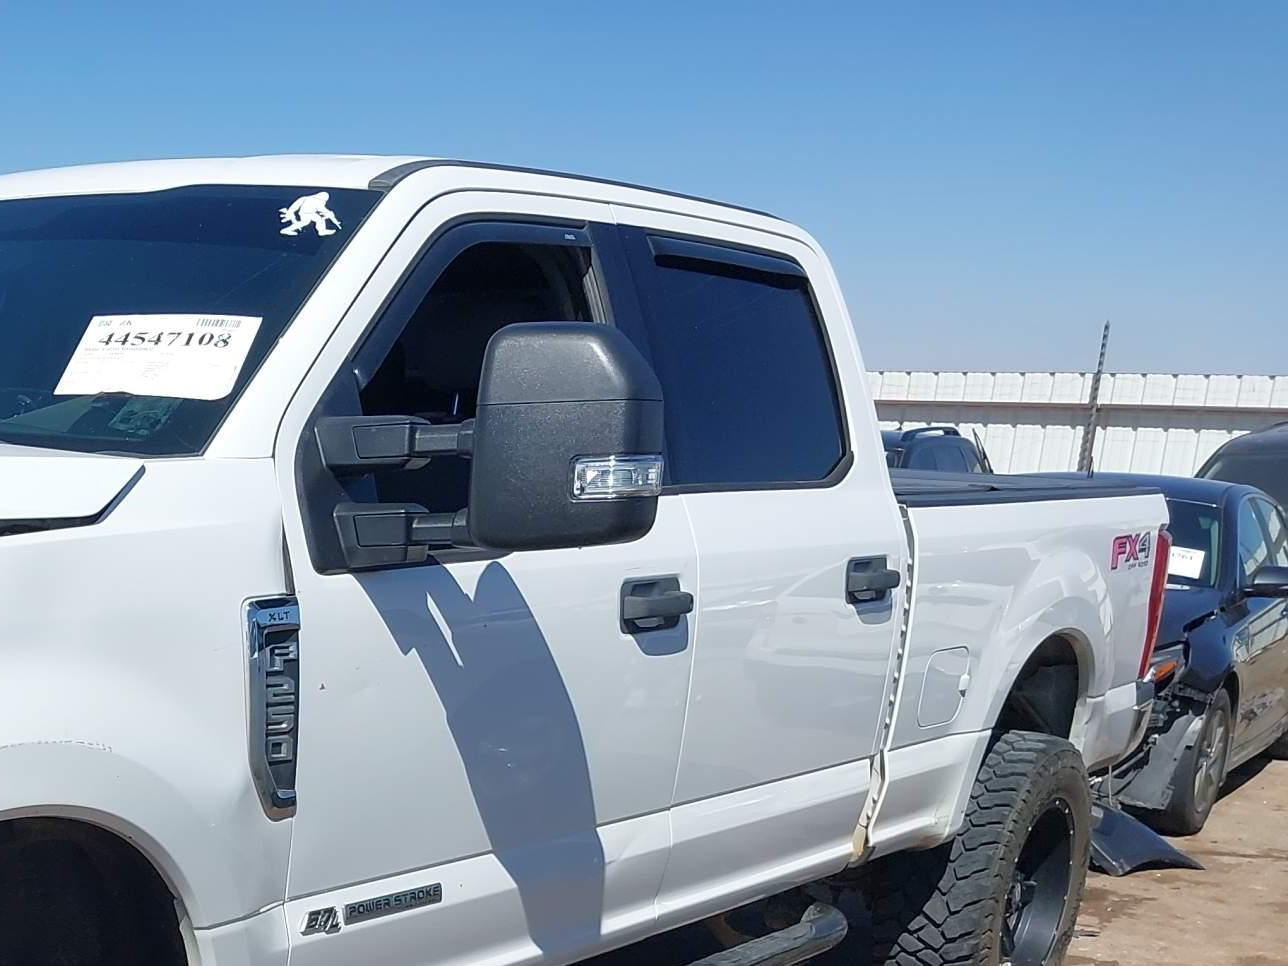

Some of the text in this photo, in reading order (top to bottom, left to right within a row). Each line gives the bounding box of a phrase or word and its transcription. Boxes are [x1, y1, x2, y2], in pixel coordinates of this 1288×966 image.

[98, 331, 232, 349] 44547108
[1111, 531, 1151, 571] FX4
[268, 610, 290, 622] XLT
[348, 897, 392, 917] POWER
[393, 885, 441, 907] STROKE
